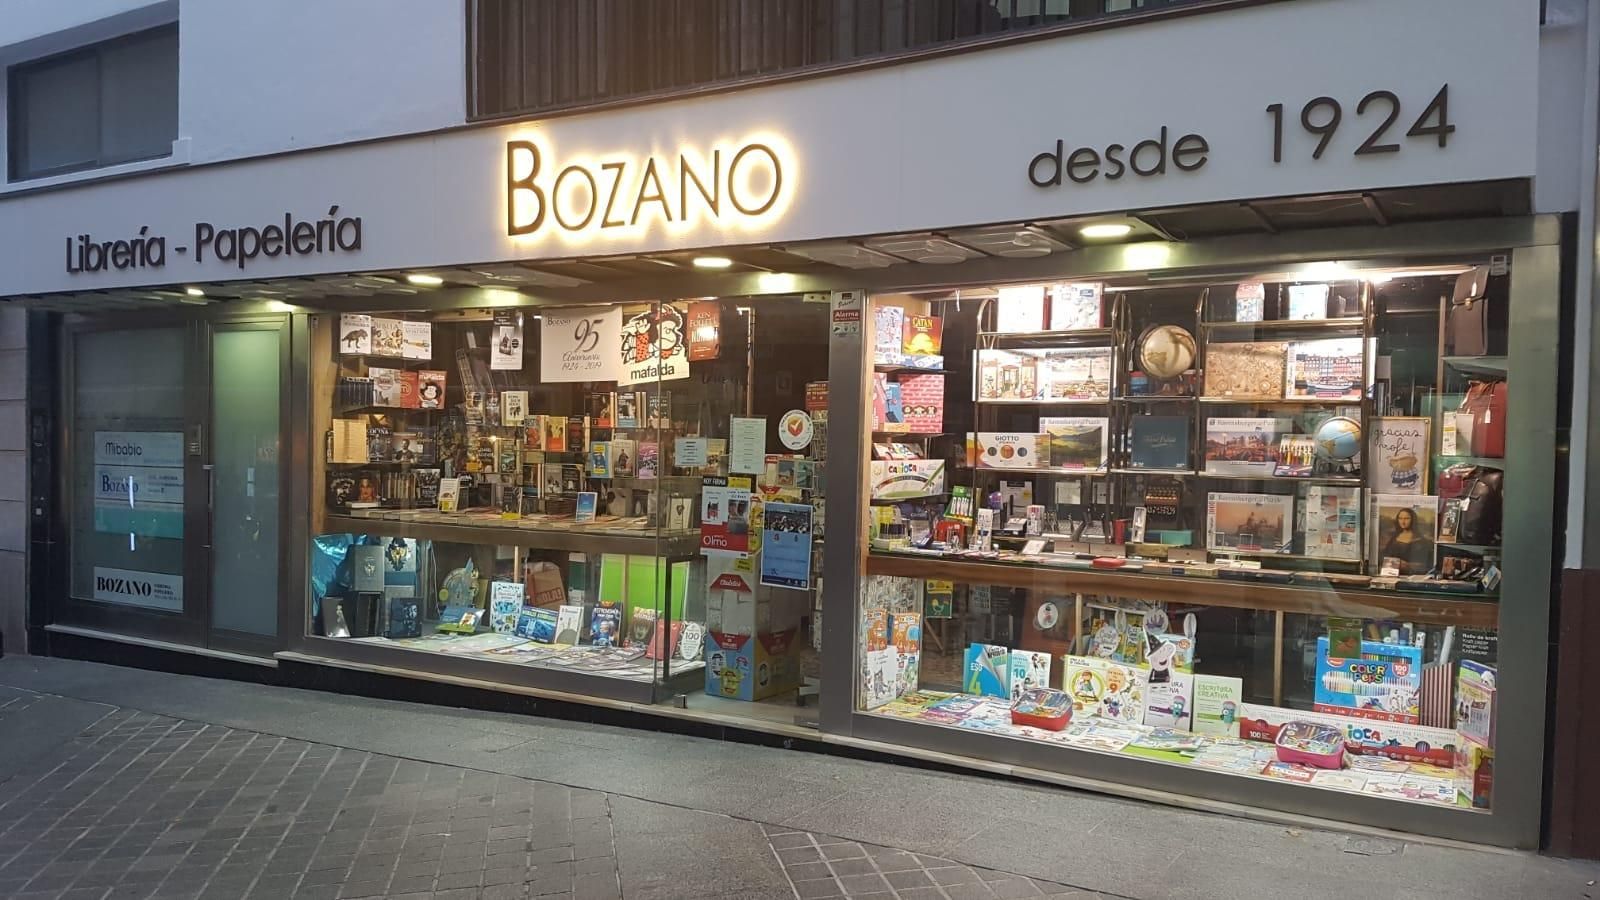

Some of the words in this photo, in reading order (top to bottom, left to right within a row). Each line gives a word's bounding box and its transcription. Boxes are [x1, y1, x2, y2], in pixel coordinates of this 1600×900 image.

[1028, 126, 1209, 187] desde
[1266, 83, 1455, 163] 1924
[507, 140, 782, 236] BOZANO
[66, 226, 165, 272] Librería
[195, 205, 361, 268] Papelería
[912, 317, 933, 329] CATAN
[574, 318, 604, 352] 95
[631, 363, 675, 379] mafalda
[97, 577, 152, 597] BOZANO
[685, 632, 699, 640] 100
[971, 662, 983, 672] ESO
[1014, 669, 1026, 679] 10
[968, 670, 982, 696] 4
[1109, 683, 1118, 693] 9
[1198, 684, 1233, 694] ESCRITURA
[1250, 731, 1262, 739] 100
